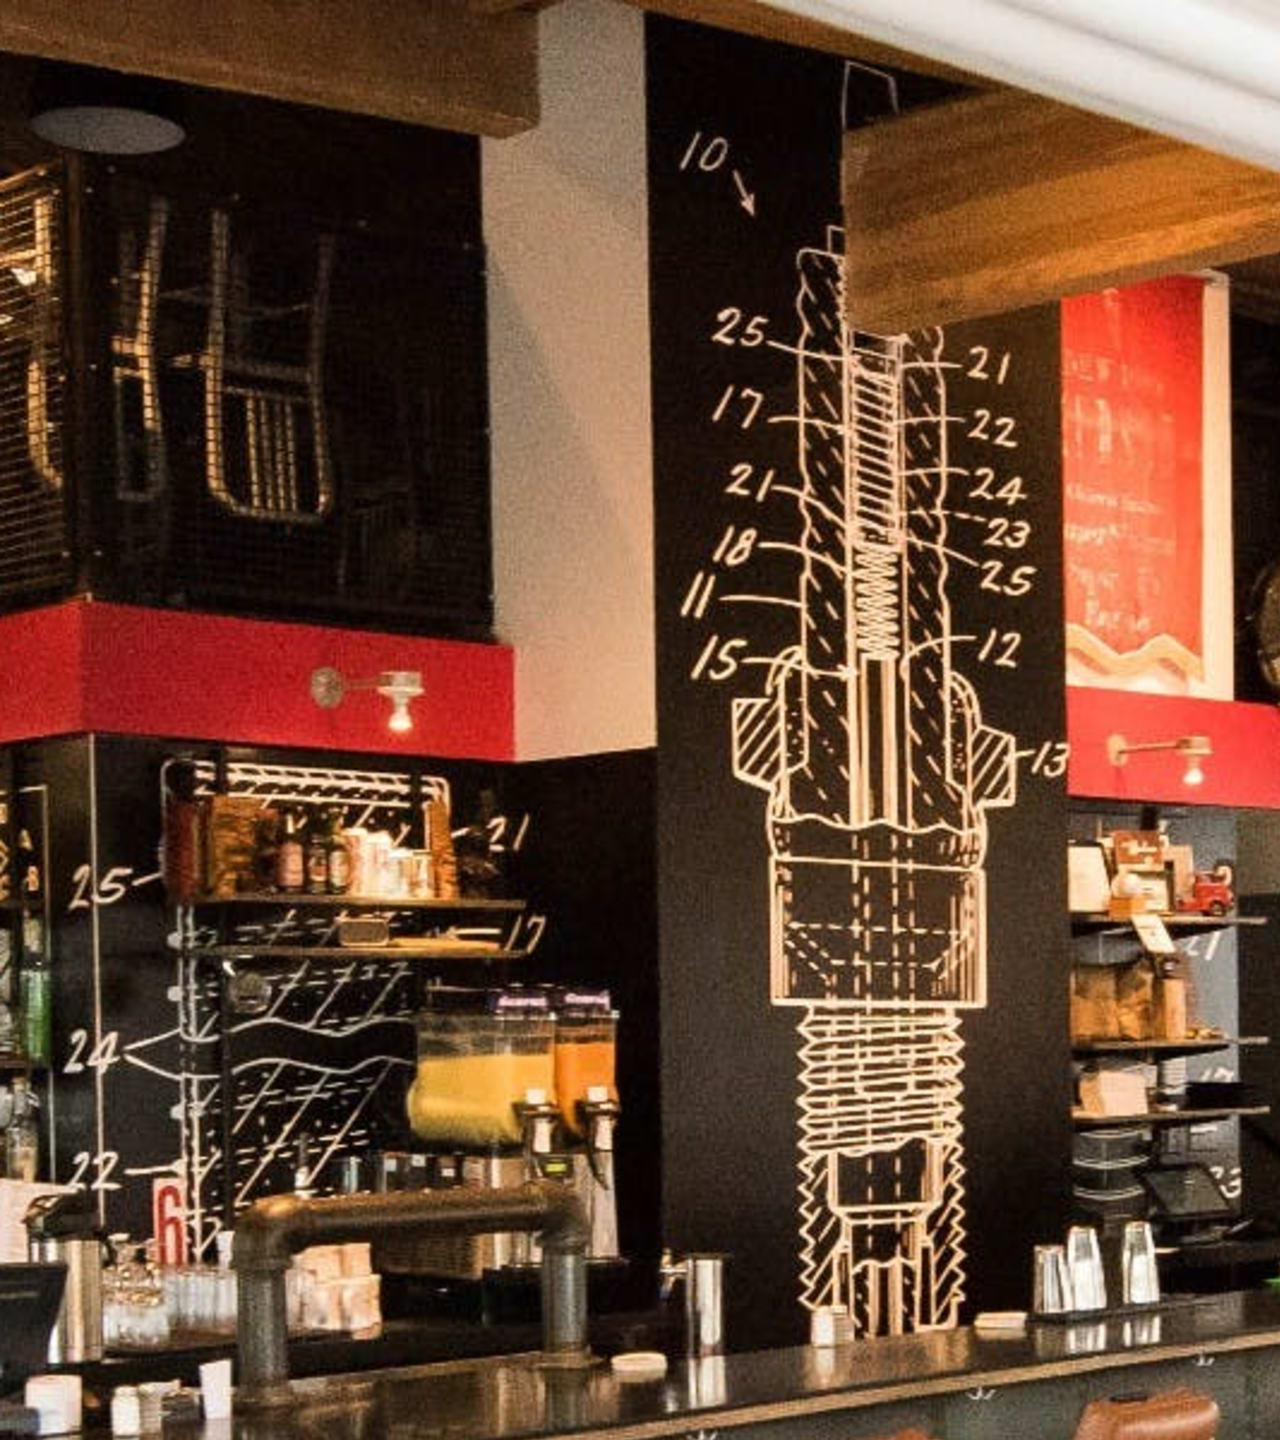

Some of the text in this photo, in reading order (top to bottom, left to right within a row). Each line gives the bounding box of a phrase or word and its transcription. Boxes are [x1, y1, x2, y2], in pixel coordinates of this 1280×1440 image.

[680, 132, 728, 171] 10
[711, 308, 770, 347] 25
[967, 347, 1010, 384] 21
[712, 385, 764, 428] 17
[967, 410, 1018, 447] 22
[725, 464, 774, 500] 21
[968, 467, 1027, 505] 24
[713, 526, 754, 566] 18
[984, 515, 1030, 548] 23
[681, 572, 716, 616] 11
[981, 560, 1038, 595] 25
[692, 635, 746, 680] 15
[977, 630, 1022, 668] 12
[1032, 742, 1068, 777] 13
[487, 813, 530, 852] 21
[68, 863, 134, 911] 25
[506, 915, 547, 954] 17
[63, 1029, 121, 1075] 24
[63, 1151, 122, 1191] 22
